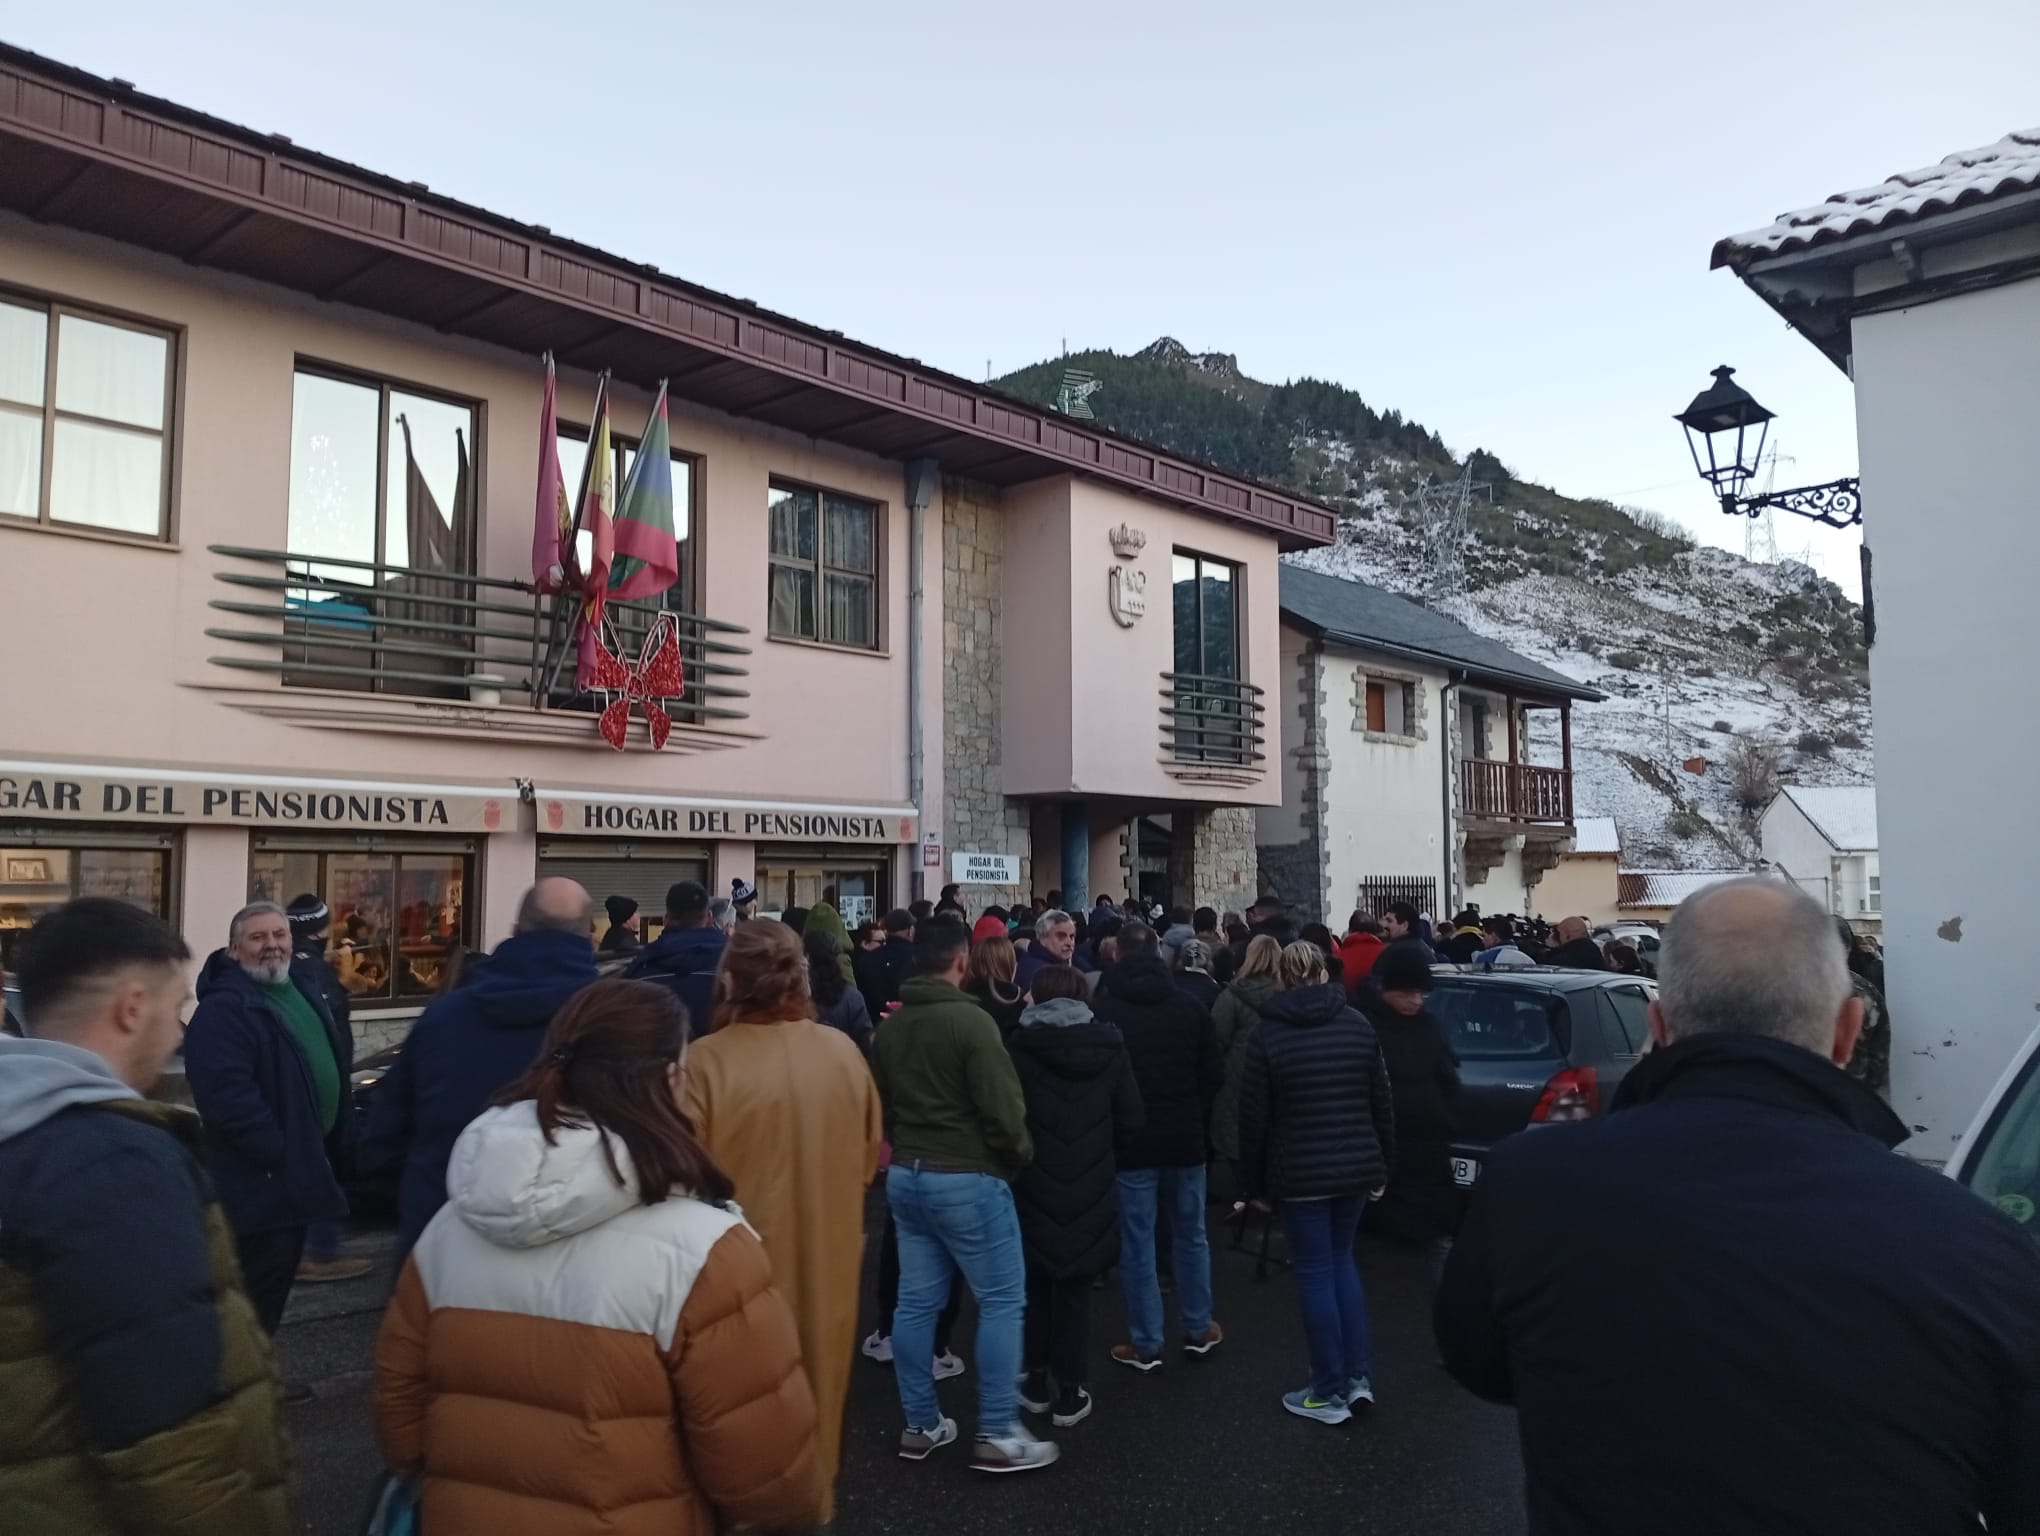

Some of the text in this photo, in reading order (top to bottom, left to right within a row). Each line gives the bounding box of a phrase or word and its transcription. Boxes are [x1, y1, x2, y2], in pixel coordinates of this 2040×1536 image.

[0, 778, 449, 825] GAR DEL PENSIONISTA
[584, 804, 886, 838] HOGAR DEL PENSIONISTA
[968, 855, 1005, 869] HOGAR DEL
[966, 869, 1009, 881] PENSIONISTA
